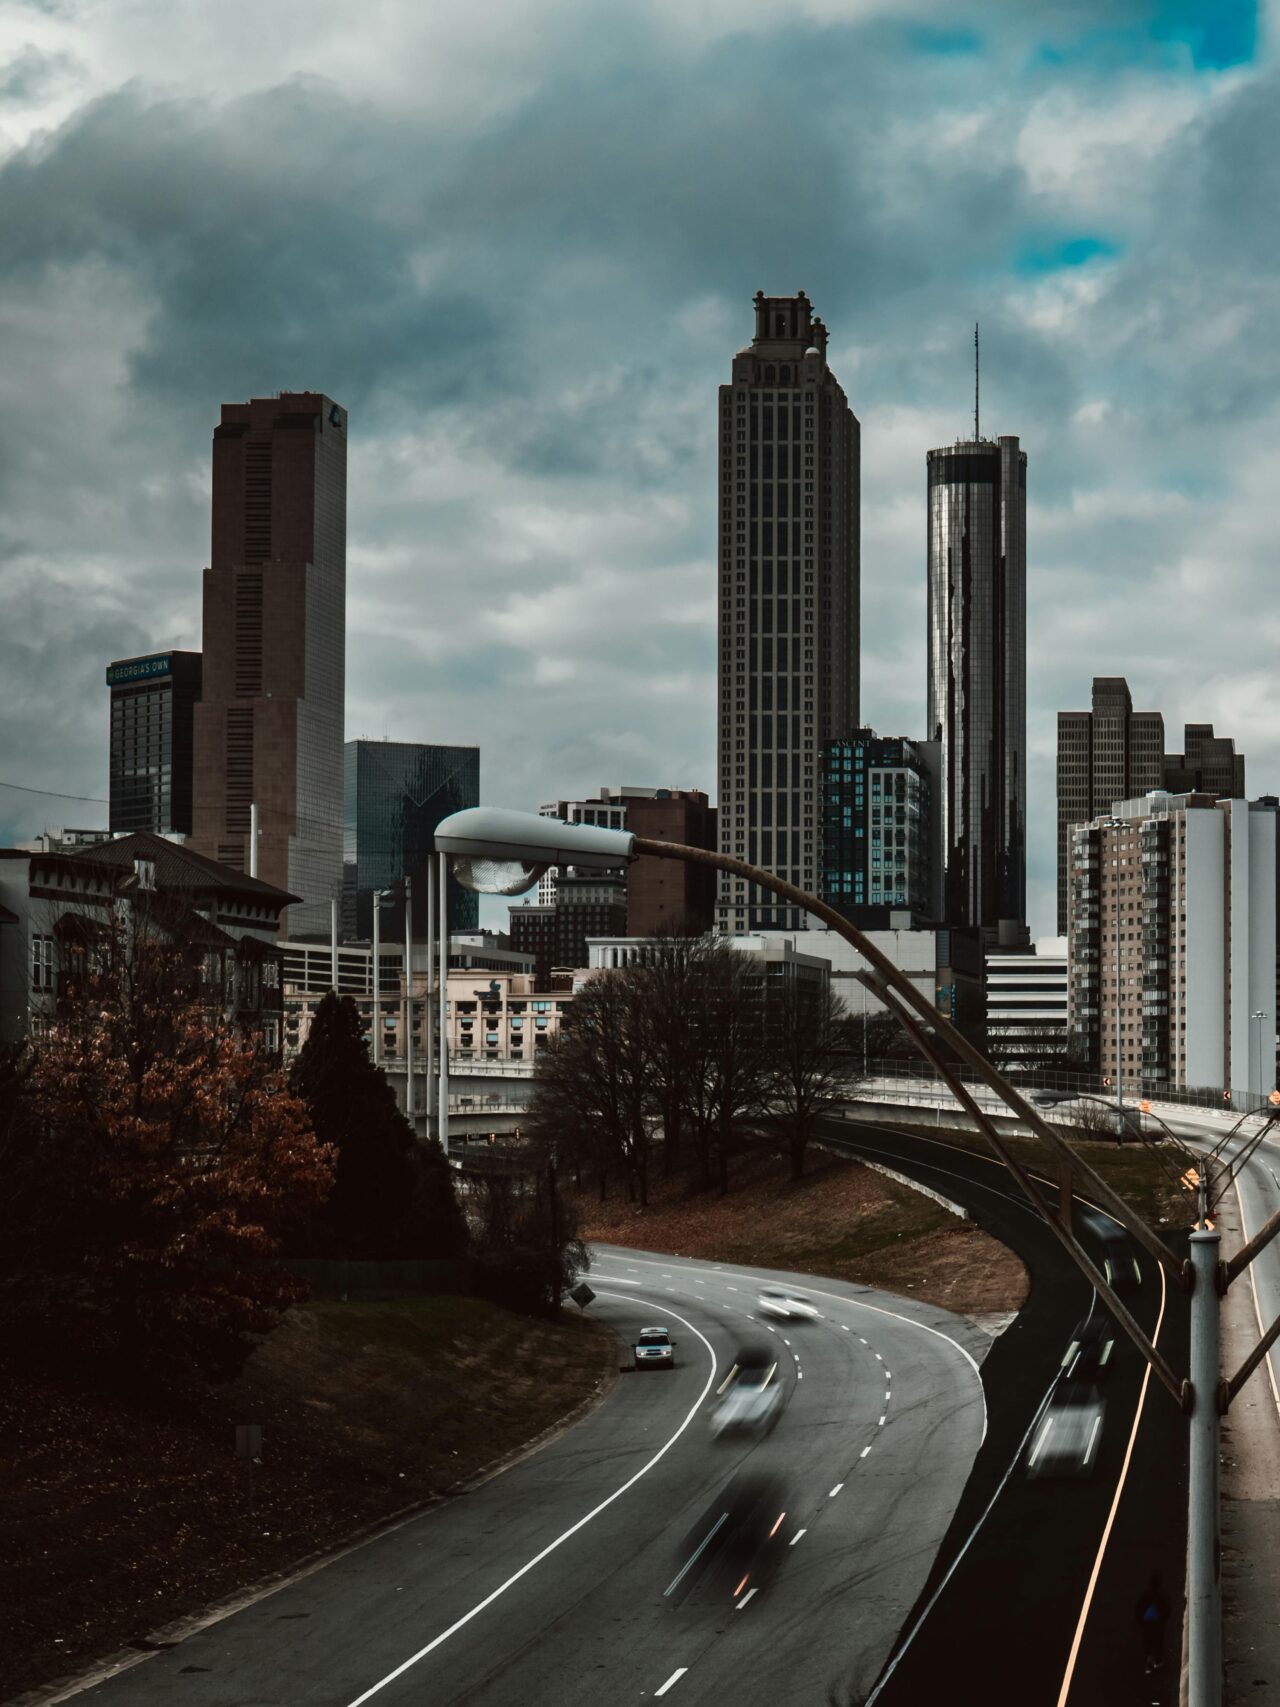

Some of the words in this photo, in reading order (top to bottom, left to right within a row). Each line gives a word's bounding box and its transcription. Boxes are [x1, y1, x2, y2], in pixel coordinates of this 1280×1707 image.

[115, 663, 150, 679] GEORGIA'S
[152, 659, 169, 672] OWN
[835, 739, 870, 748] ASCENT
